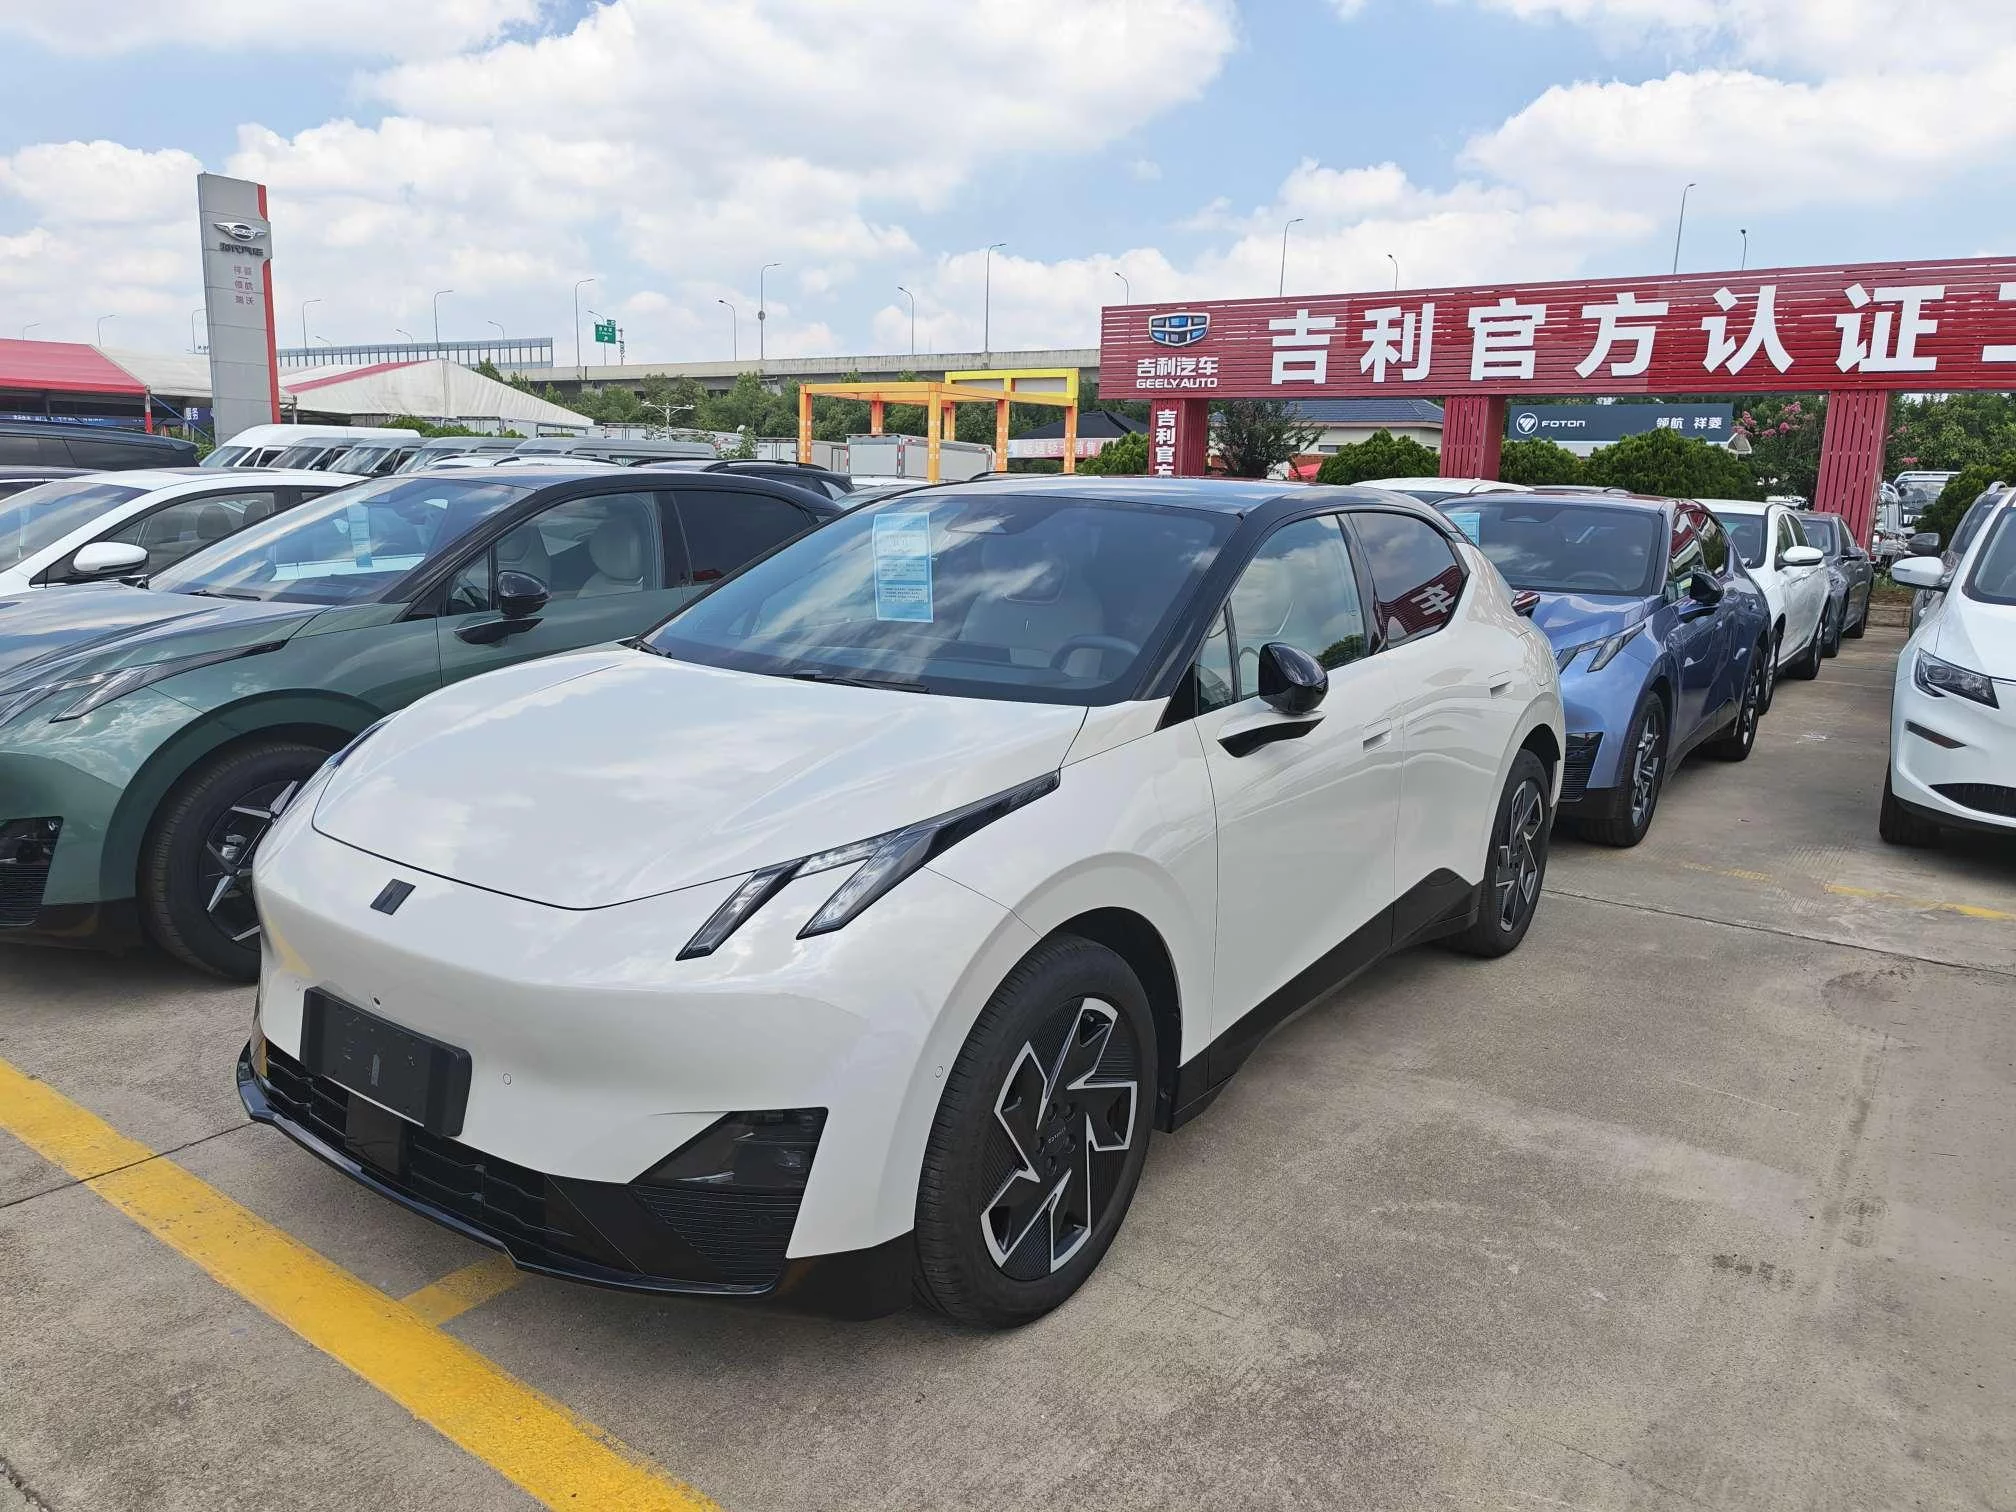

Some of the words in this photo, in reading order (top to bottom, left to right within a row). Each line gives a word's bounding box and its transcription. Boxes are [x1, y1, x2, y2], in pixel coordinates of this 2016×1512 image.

[1137, 356, 1219, 376] 吉利汽车
[1136, 378, 1180, 389] GEELY
[1180, 377, 1218, 388] AUTO
[1541, 420, 1586, 428] FOTON
[1656, 417, 1685, 429] 领航
[1693, 416, 1723, 429] 祥菱
